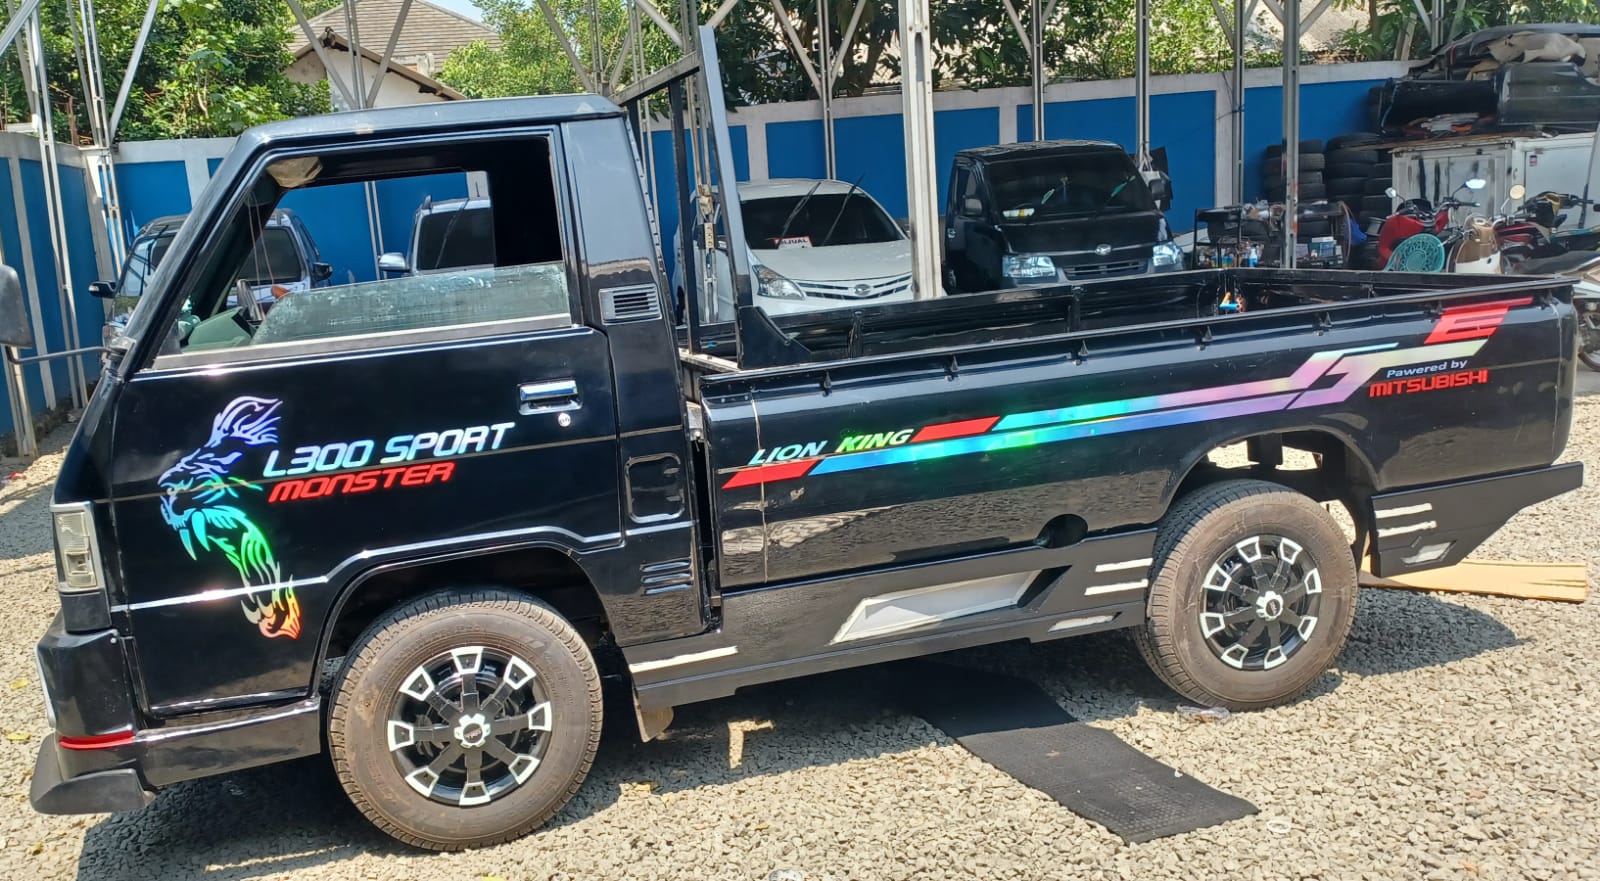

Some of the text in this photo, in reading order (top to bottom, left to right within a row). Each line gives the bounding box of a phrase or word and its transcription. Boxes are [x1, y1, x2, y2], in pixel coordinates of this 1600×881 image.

[1450, 359, 1468, 369] by
[1369, 369, 1489, 398] MITSUBISHI
[262, 422, 516, 478] L300 SPORT
[748, 428, 915, 466] LION KING
[267, 462, 457, 503] MONSTER
